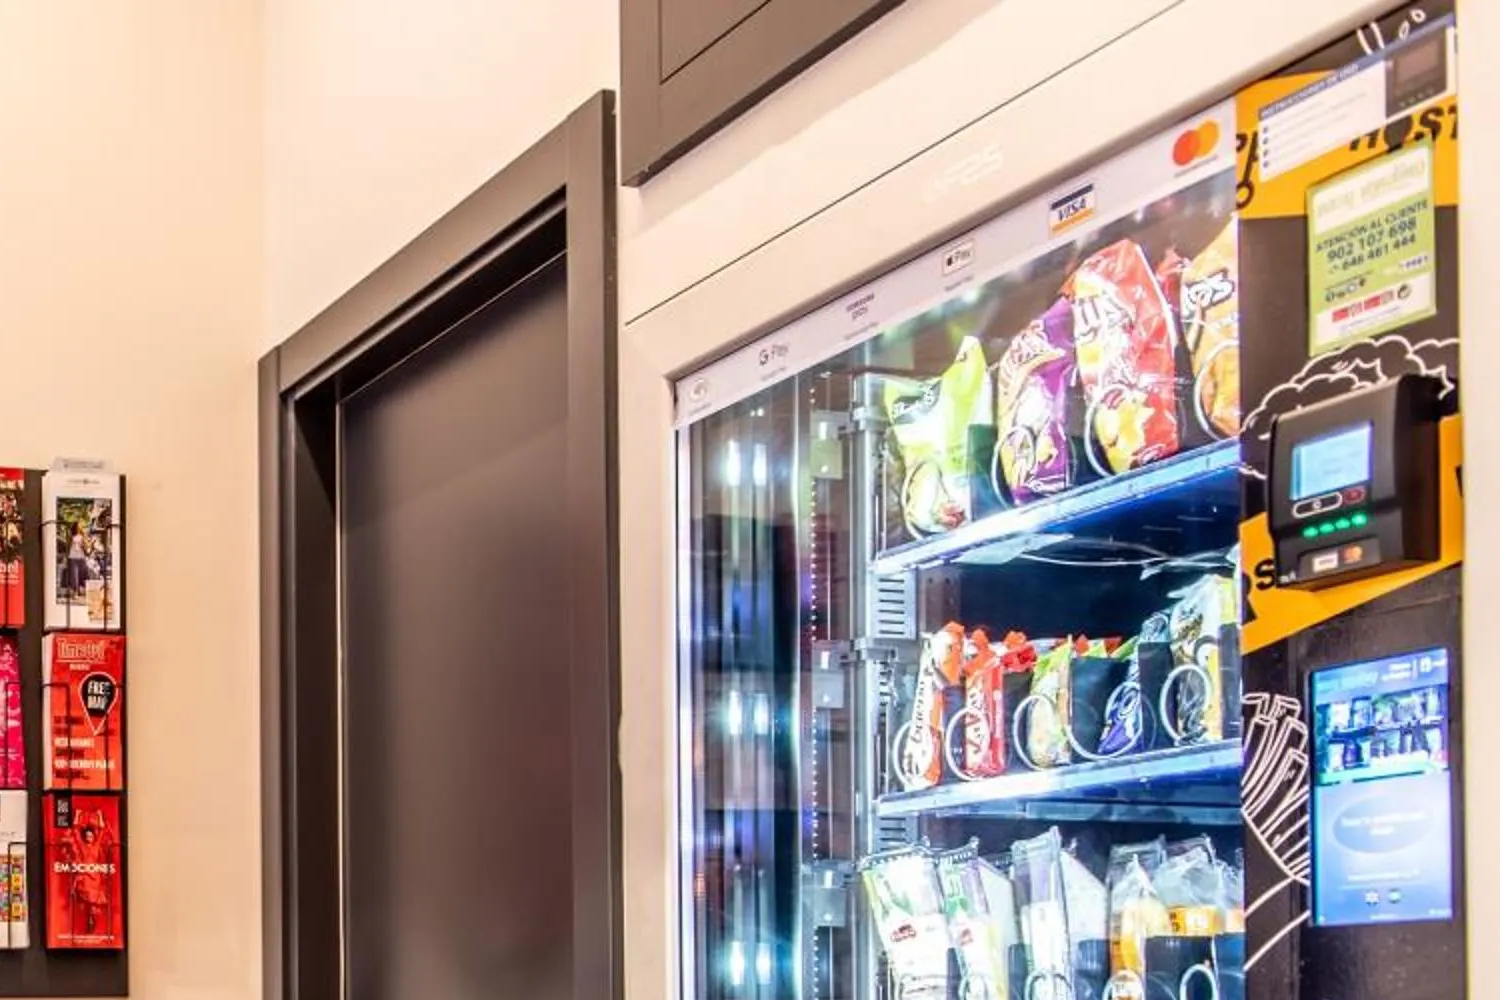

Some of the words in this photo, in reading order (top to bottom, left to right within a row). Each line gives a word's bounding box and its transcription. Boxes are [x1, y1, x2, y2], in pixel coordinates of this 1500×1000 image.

[1057, 197, 1087, 223] VISA
[1384, 198, 1429, 225] CLIENTE
[87, 680, 112, 696] FREE
[53, 862, 117, 875] EMOCIONES
